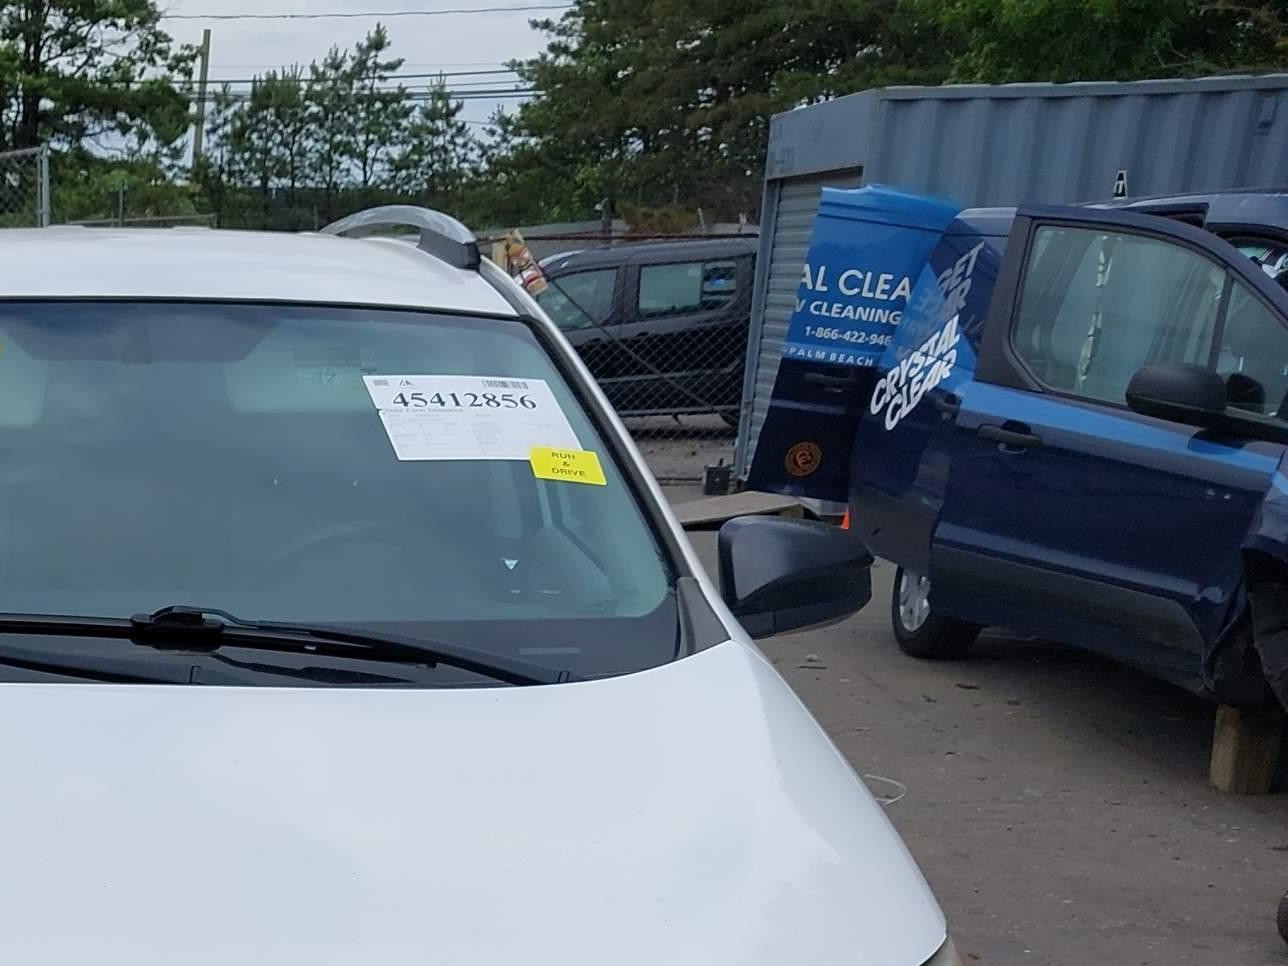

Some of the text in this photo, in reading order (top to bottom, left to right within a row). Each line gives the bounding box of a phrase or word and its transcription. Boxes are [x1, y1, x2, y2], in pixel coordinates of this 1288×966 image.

[809, 300, 904, 326] CLEANING
[788, 346, 874, 368] PALM BEACH
[870, 313, 961, 415] CRYSTAL
[392, 392, 537, 410] 45412856
[884, 349, 958, 431] CLEAR
[551, 451, 576, 460] RUN
[551, 467, 586, 478] DRIVE
